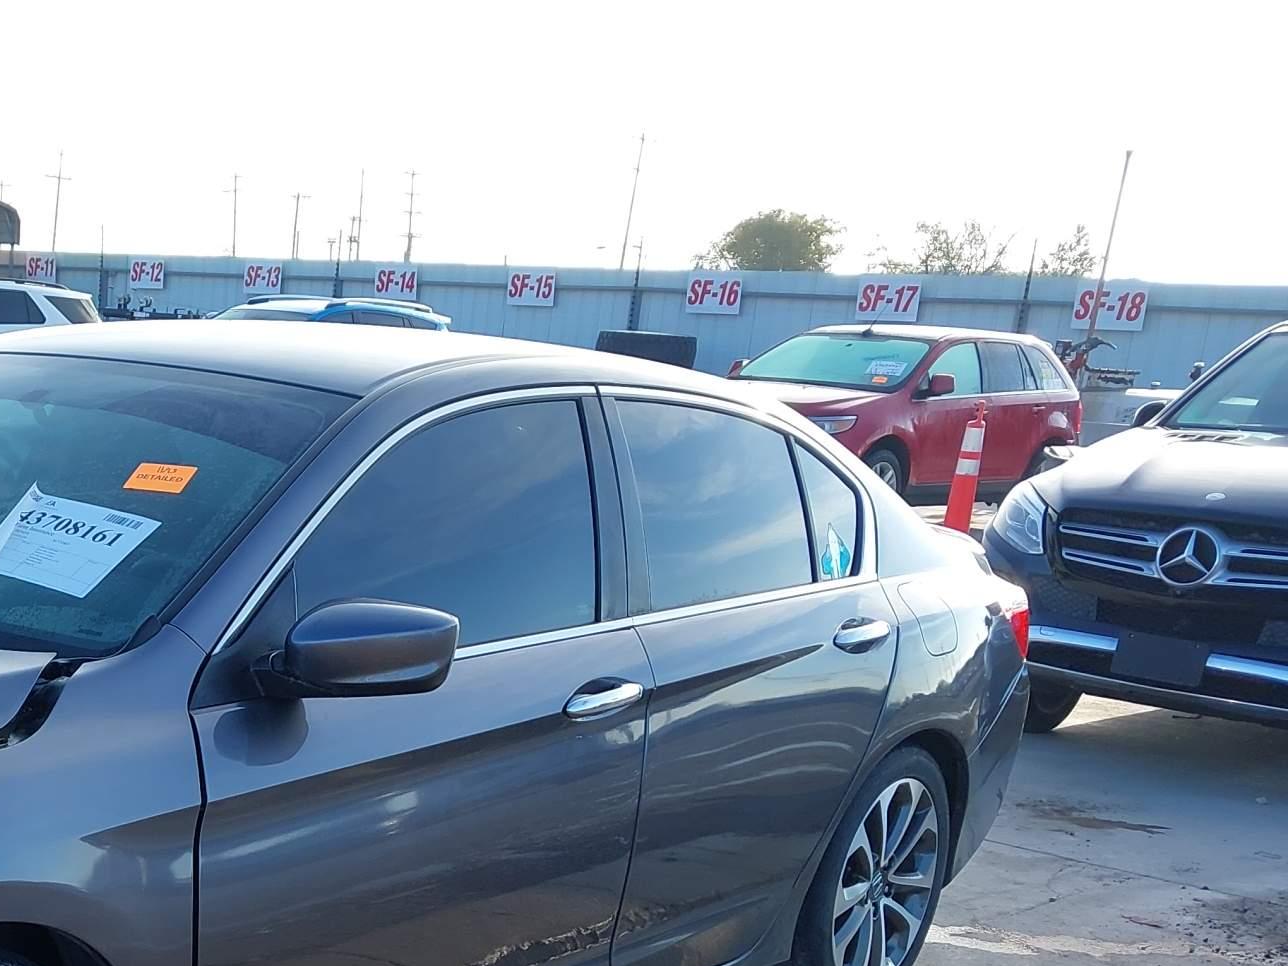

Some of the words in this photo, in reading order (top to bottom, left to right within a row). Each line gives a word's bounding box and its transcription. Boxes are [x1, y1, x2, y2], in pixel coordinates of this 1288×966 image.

[27, 255, 55, 277] SF-11
[131, 261, 163, 283] SF-12
[244, 265, 281, 288] SF-13
[375, 269, 416, 293] SF-14
[508, 273, 555, 299] SF-15
[687, 279, 741, 307] SF-16
[858, 284, 920, 313] SF-17
[1074, 290, 1146, 322] SF-18
[136, 473, 184, 483] DETAILED
[18, 509, 125, 547] 43708161
